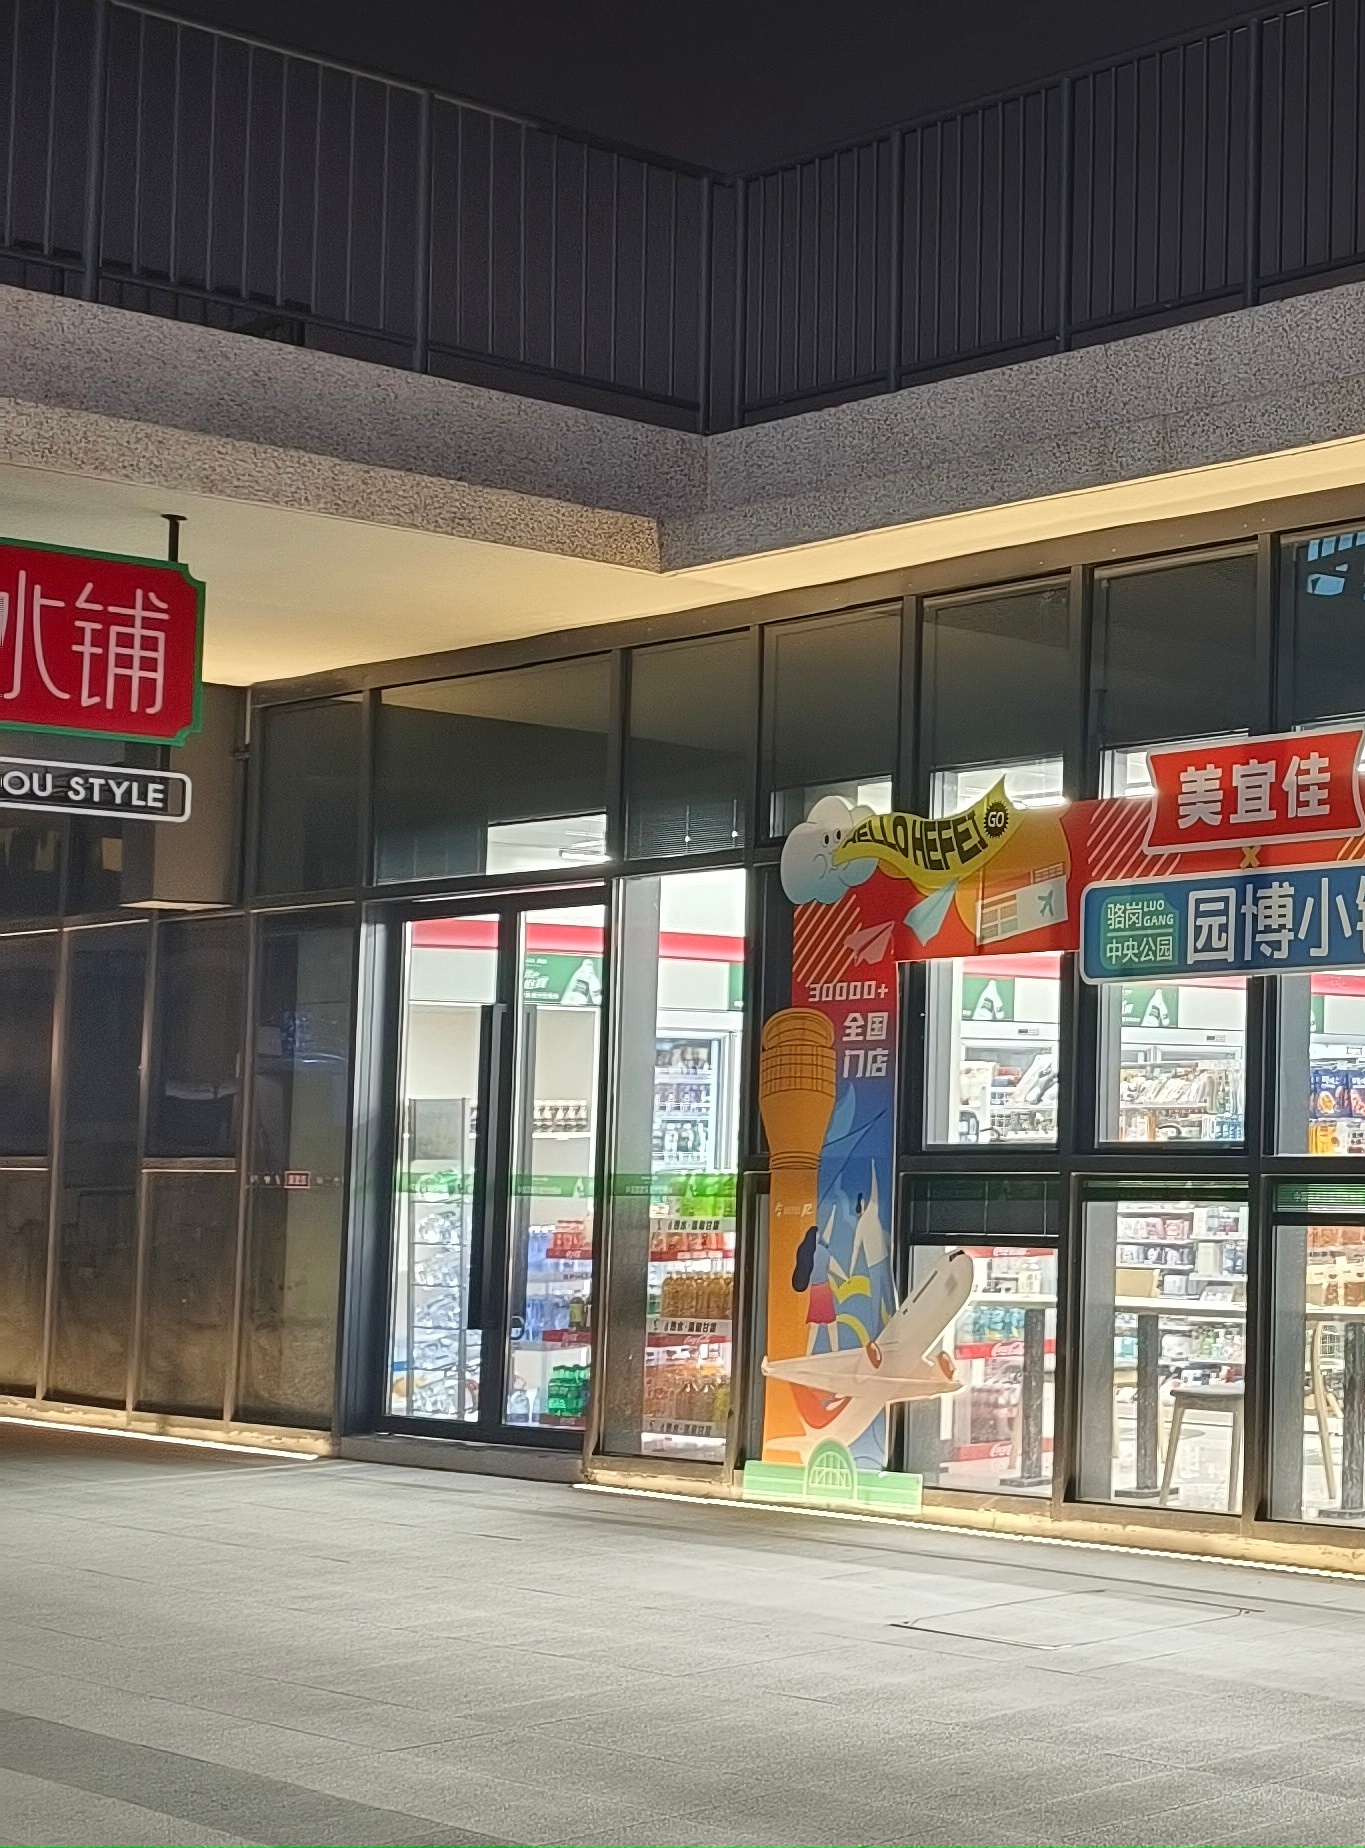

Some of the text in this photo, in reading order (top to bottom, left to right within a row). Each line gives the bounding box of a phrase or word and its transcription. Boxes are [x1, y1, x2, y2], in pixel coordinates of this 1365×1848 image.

[0, 771, 165, 808] OU STYLE
[1177, 751, 1331, 829] 美宜佳
[987, 812, 1005, 828] GO
[842, 810, 989, 870] HELLO HEFEI
[1107, 902, 1142, 930] 骆岗
[1143, 900, 1165, 912] LUO
[1143, 913, 1174, 926] GANG
[1106, 936, 1173, 965] 中央公园
[808, 981, 889, 1002] 30000+
[842, 1012, 889, 1041] 全国
[842, 1049, 889, 1078] 门店
